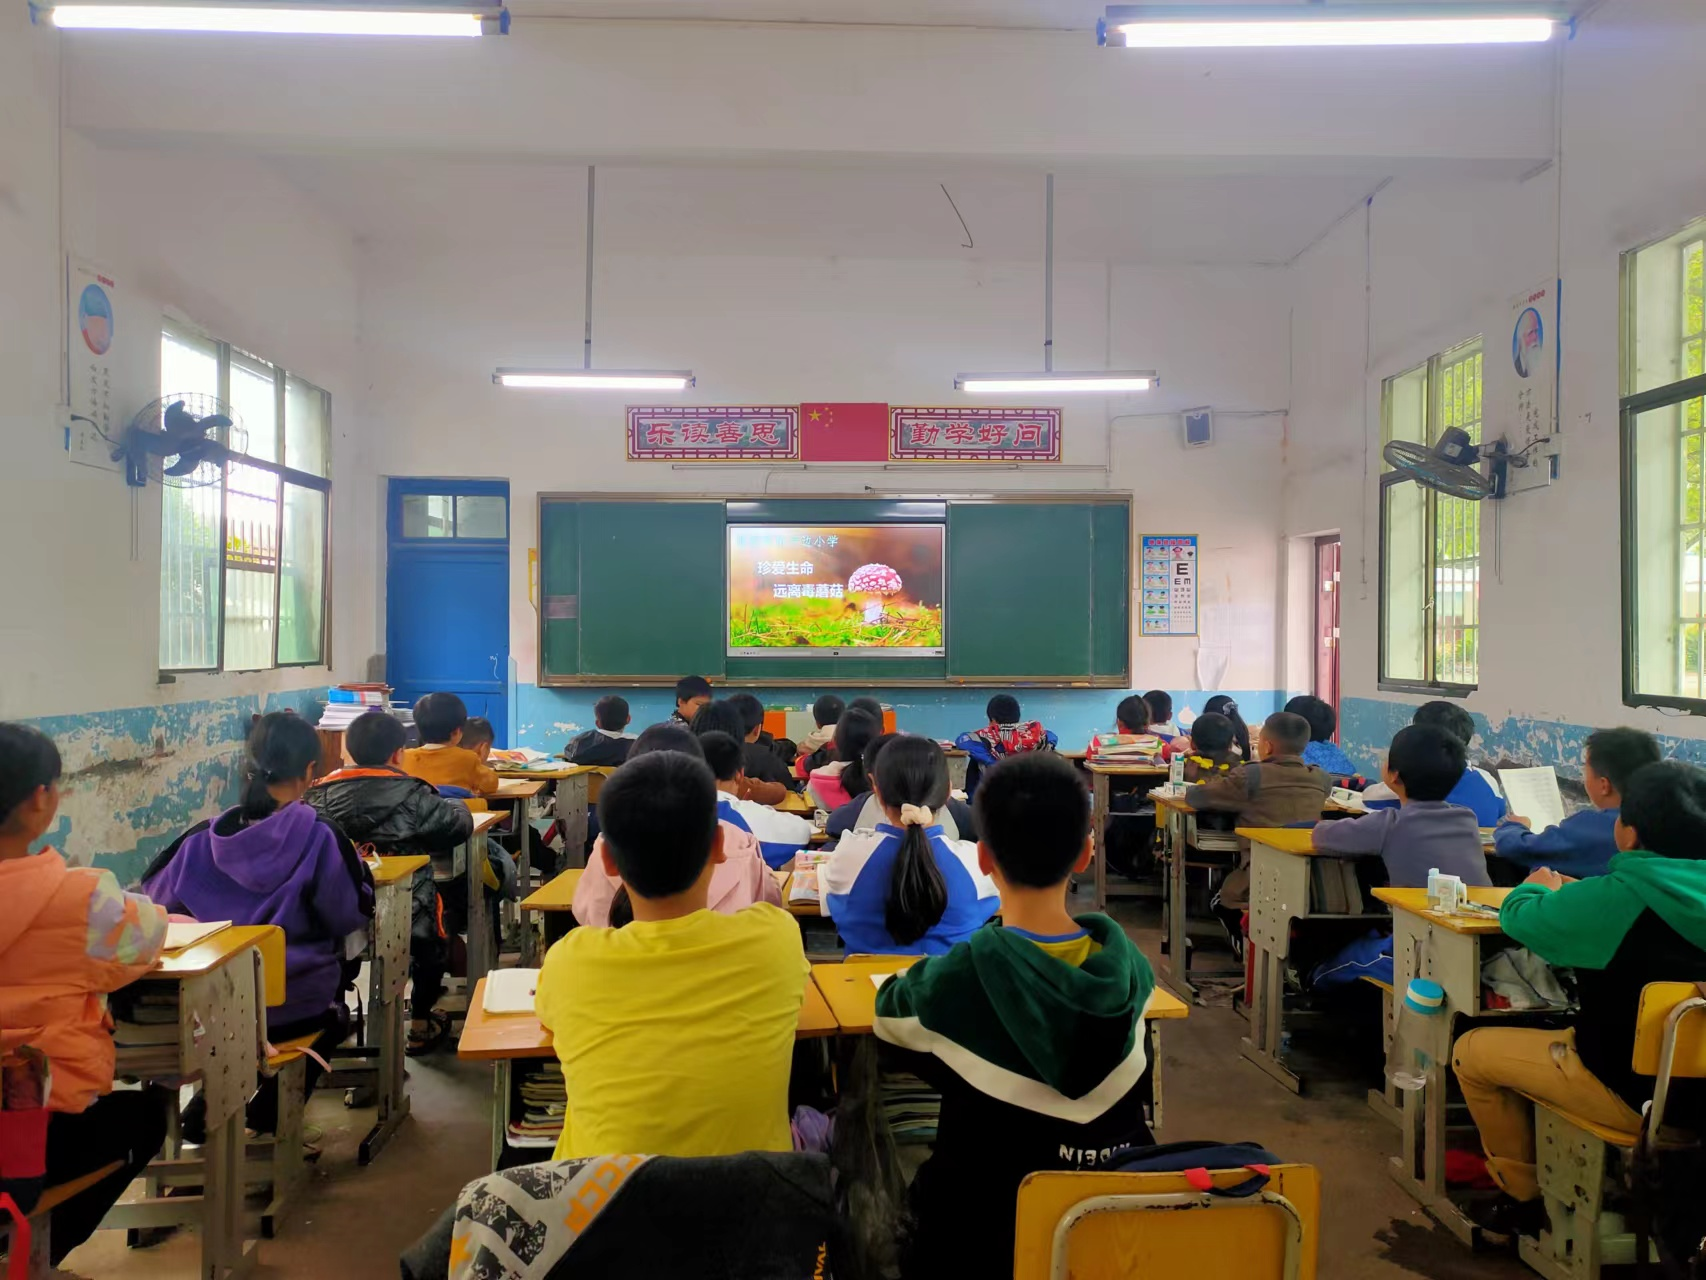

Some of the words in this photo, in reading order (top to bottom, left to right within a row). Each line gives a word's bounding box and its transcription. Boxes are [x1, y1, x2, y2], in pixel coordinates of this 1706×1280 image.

[645, 422, 782, 446] 乐读善思
[910, 422, 1044, 447] 勤学好问
[757, 561, 814, 575] 珍爱生命
[773, 584, 844, 598] 远离毒蘑菇
